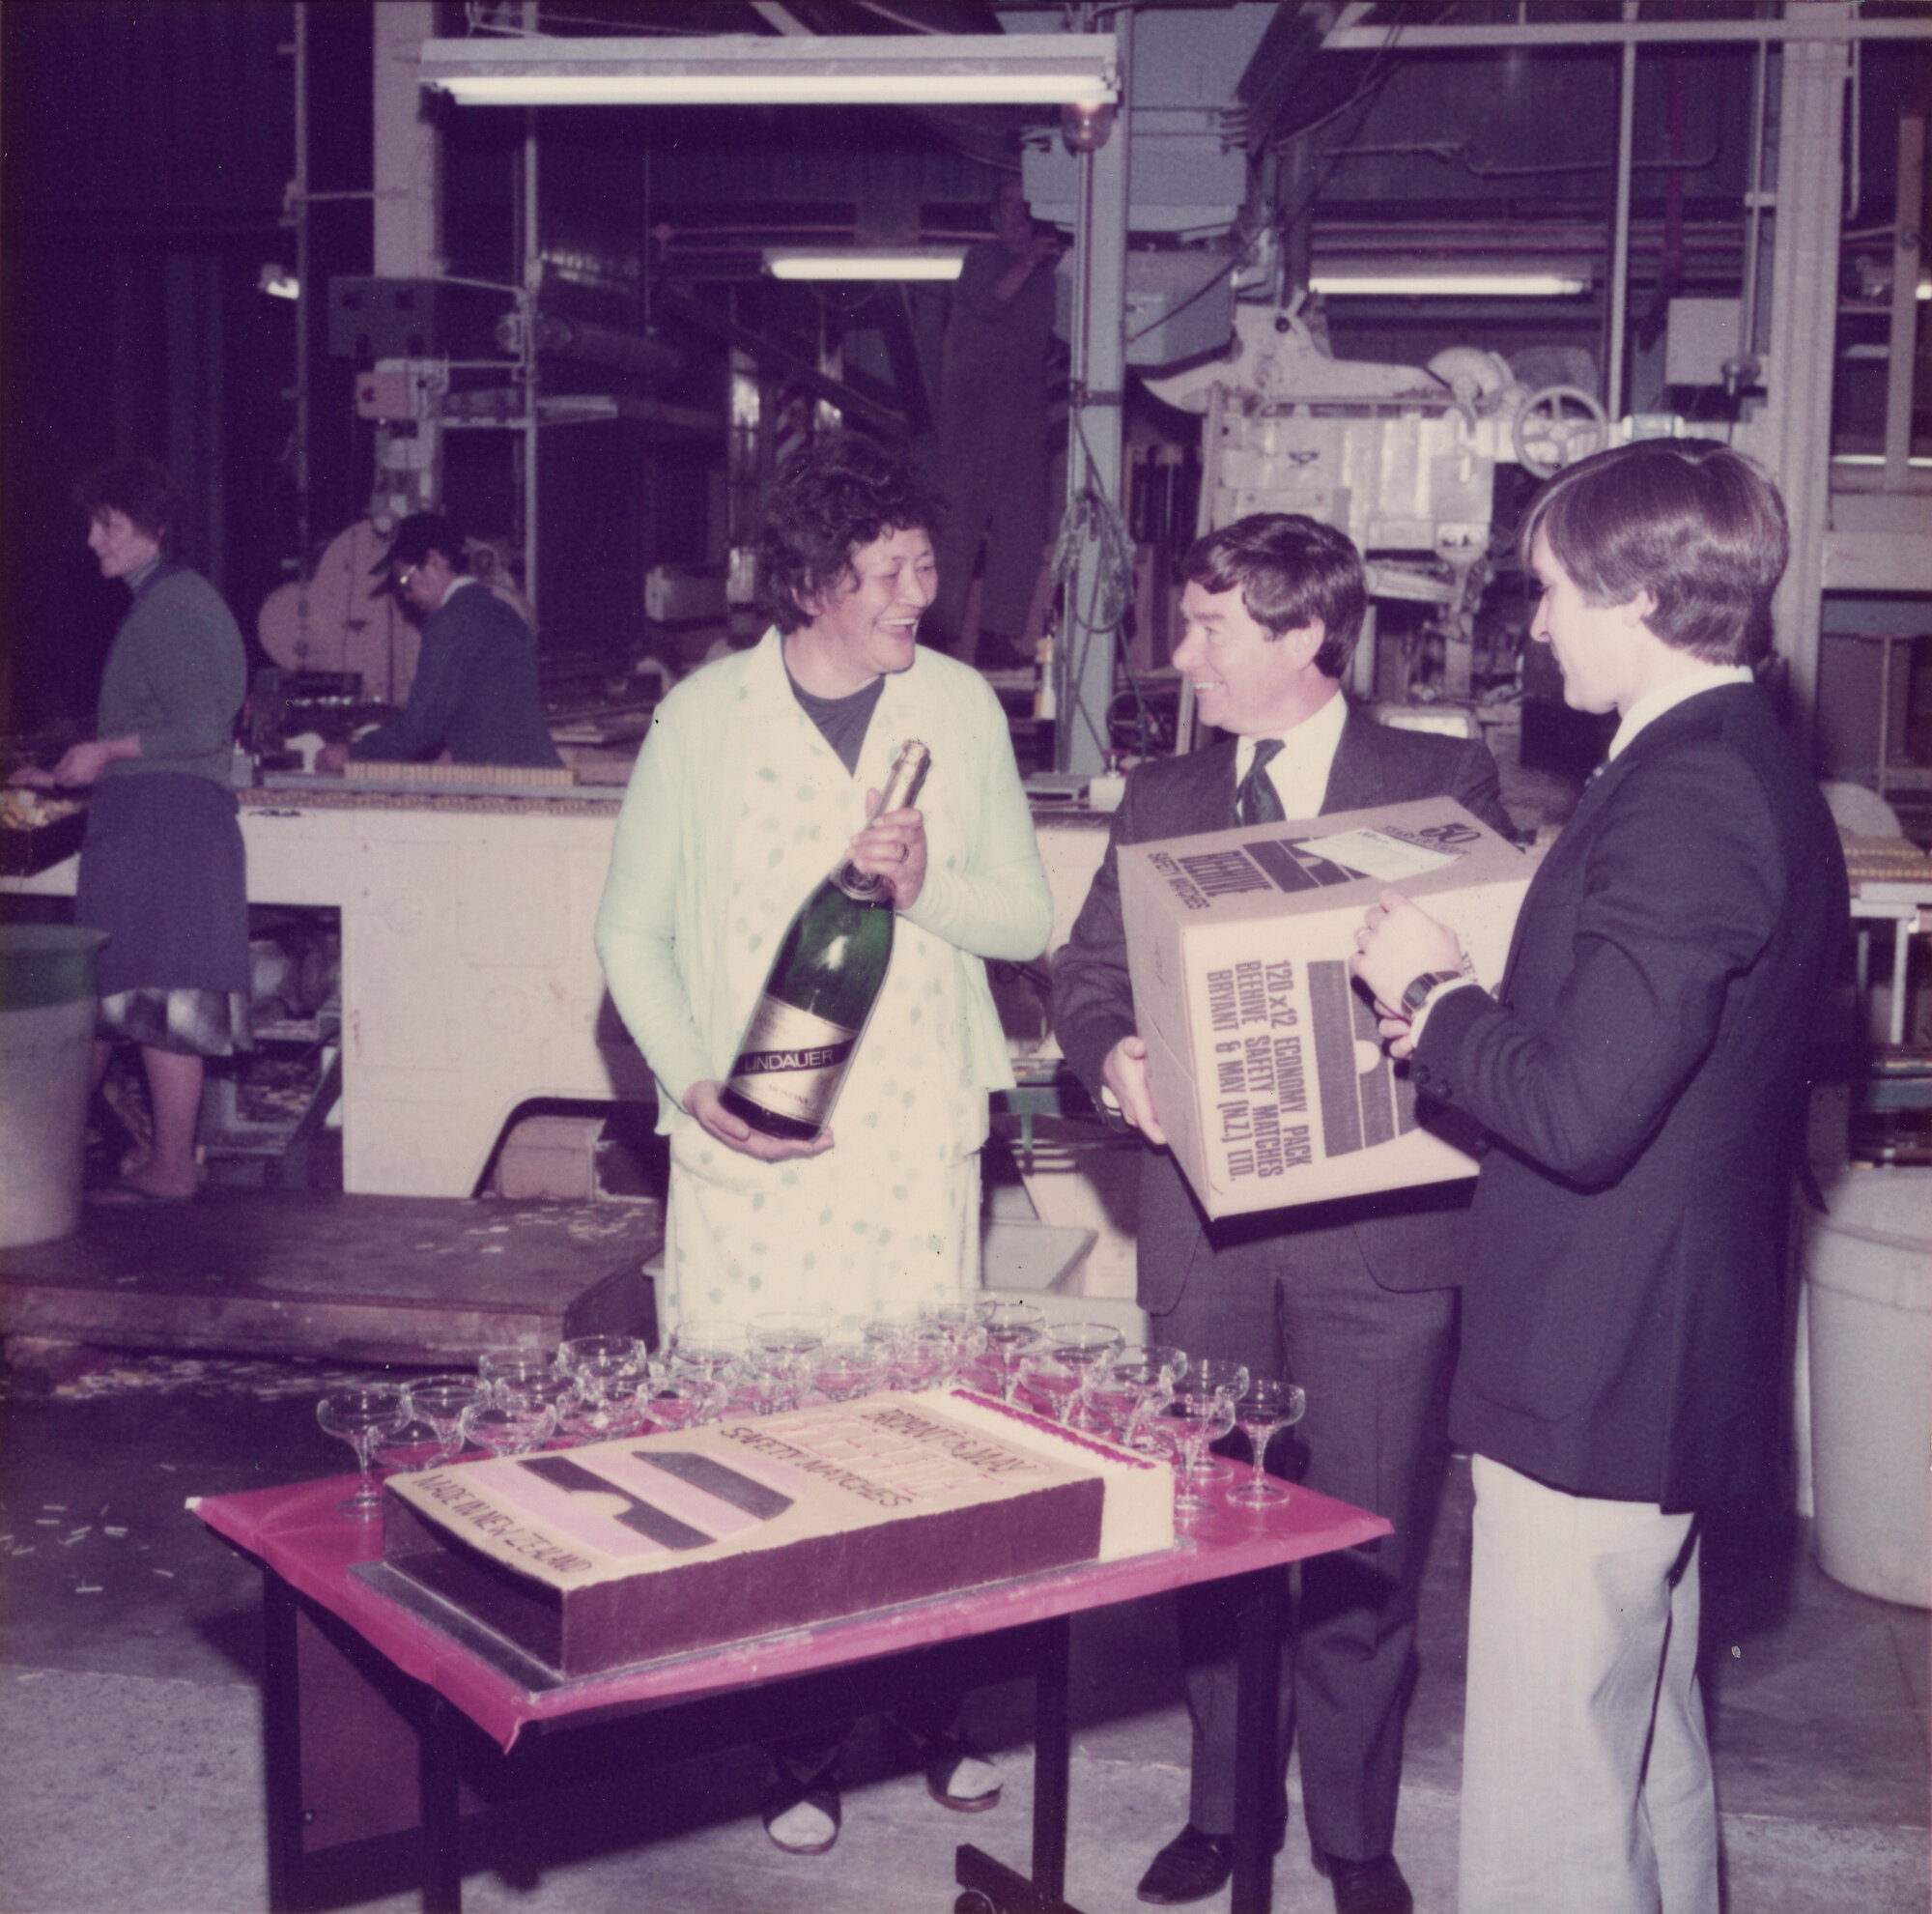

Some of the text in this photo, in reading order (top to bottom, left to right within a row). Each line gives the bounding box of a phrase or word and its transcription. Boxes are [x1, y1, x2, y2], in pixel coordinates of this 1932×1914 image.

[1177, 850, 1273, 898] BEEHIVE
[1207, 969, 1239, 1032] BRYANT
[744, 1049, 835, 1072] LINDAUER
[1215, 1040, 1242, 1054] &
[1236, 960, 1285, 1178] BEEHIVE SAFETY MATCHES
[1217, 1060, 1246, 1094] MAY
[1272, 1036, 1313, 1167] ECONOMY PACK
[1227, 1149, 1255, 1182] LTD.
[720, 1426, 913, 1507] SAFETY MATCHES
[412, 1473, 593, 1573] MADE IN NEW ZEALAND
